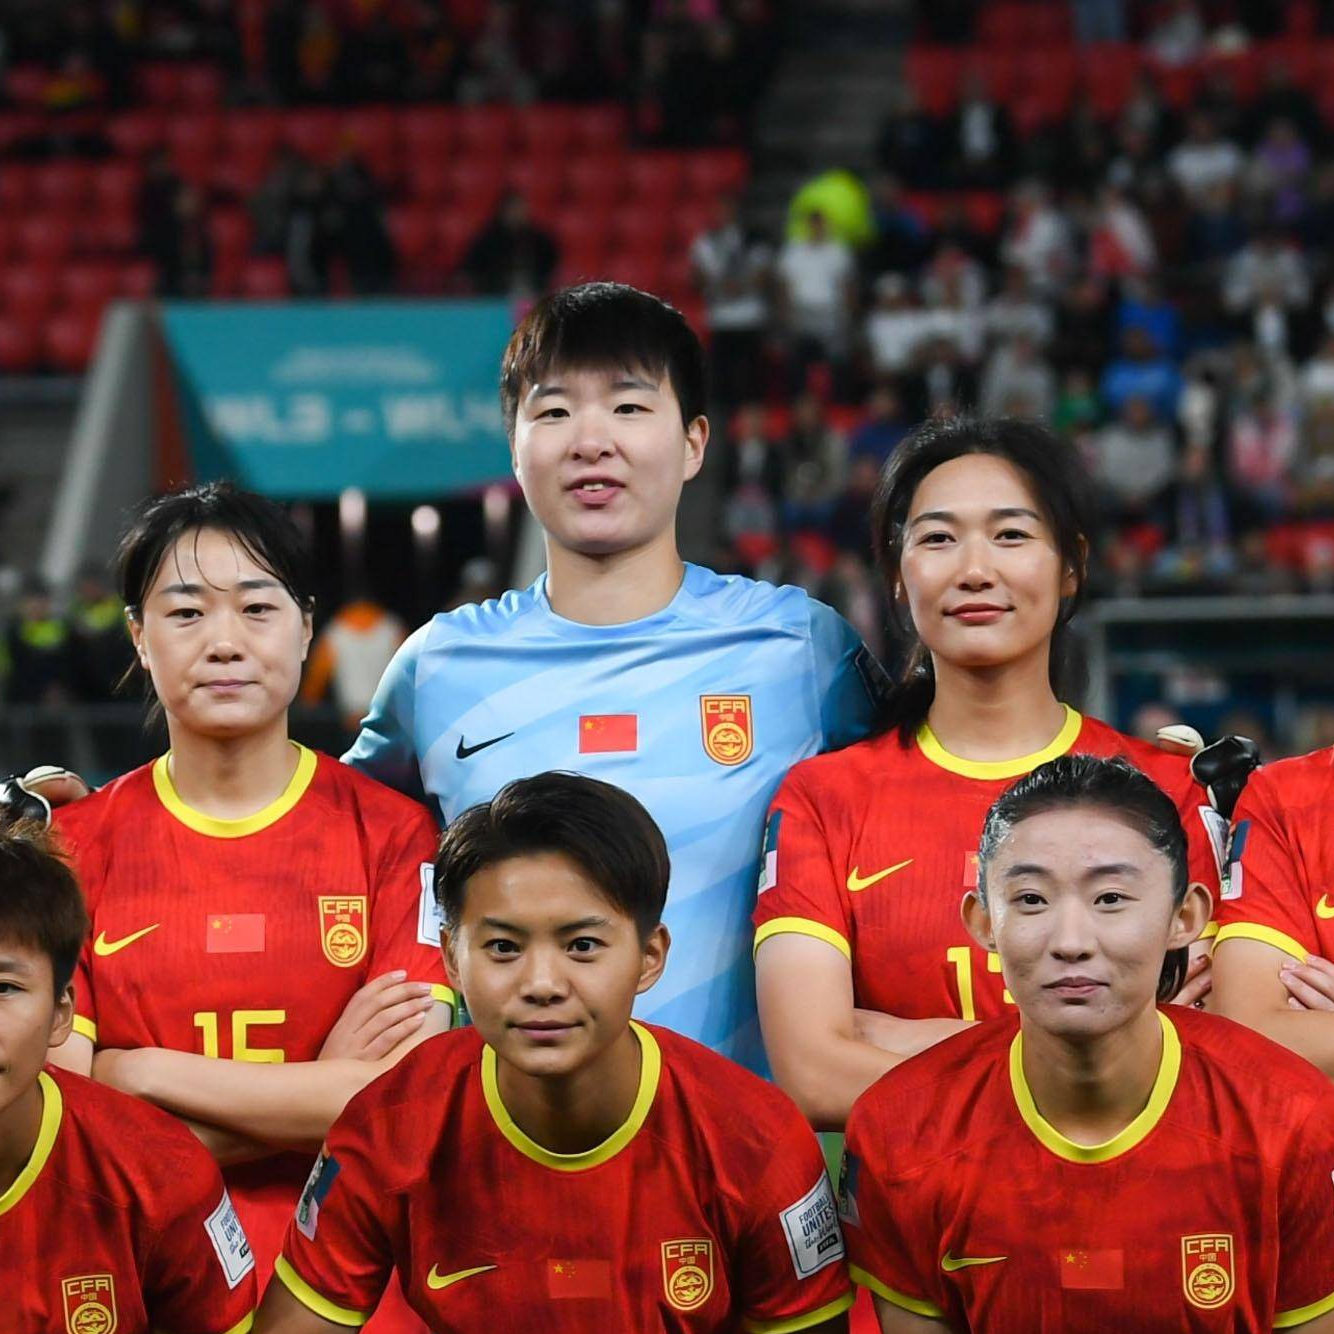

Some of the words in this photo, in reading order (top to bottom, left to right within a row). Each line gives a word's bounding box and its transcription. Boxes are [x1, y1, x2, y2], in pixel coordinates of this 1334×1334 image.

[707, 701, 746, 714] CFA
[323, 901, 363, 914] CFA
[666, 1243, 707, 1258] CFA
[1187, 1239, 1229, 1254] CFA
[67, 1279, 109, 1296] CFA
